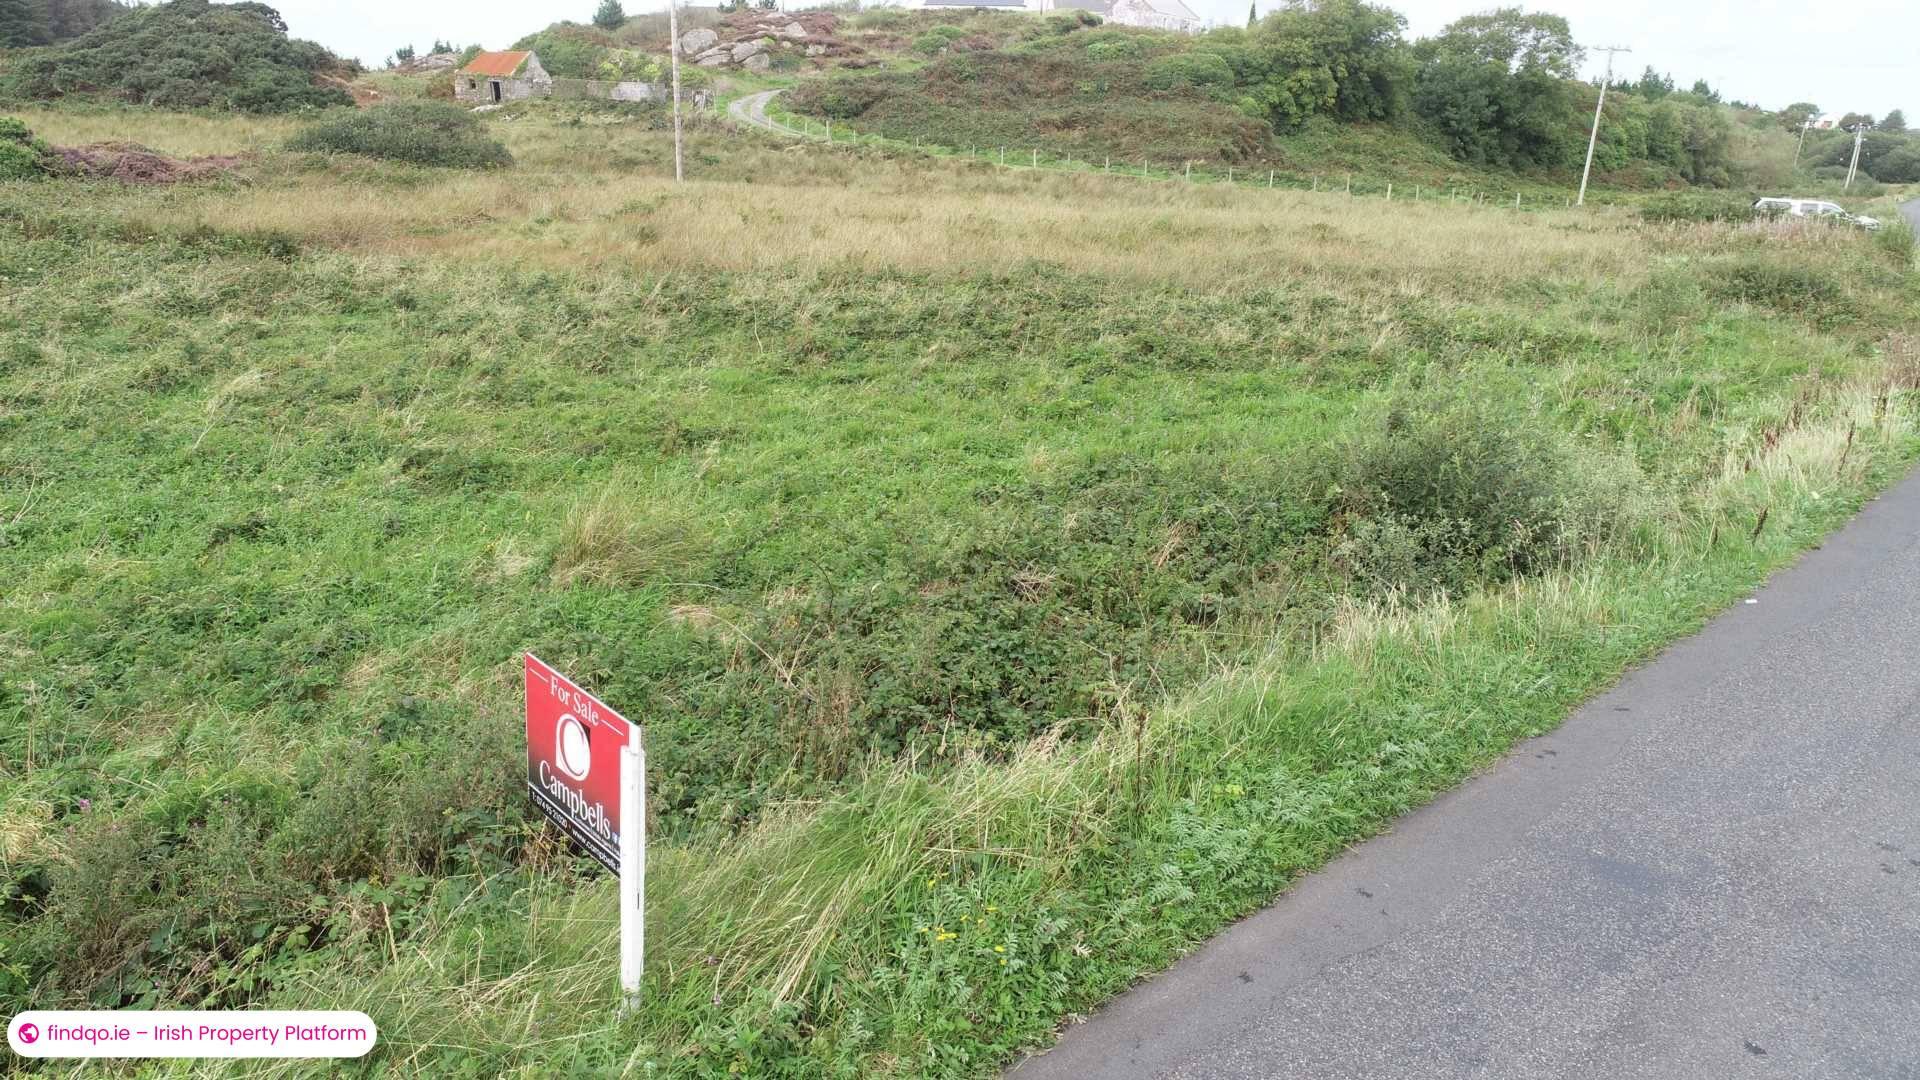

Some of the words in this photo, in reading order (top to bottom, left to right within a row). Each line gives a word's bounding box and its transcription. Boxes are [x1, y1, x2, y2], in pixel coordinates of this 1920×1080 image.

[550, 674, 571, 705] For
[573, 694, 599, 726] Sale
[539, 760, 611, 840] Campbells
